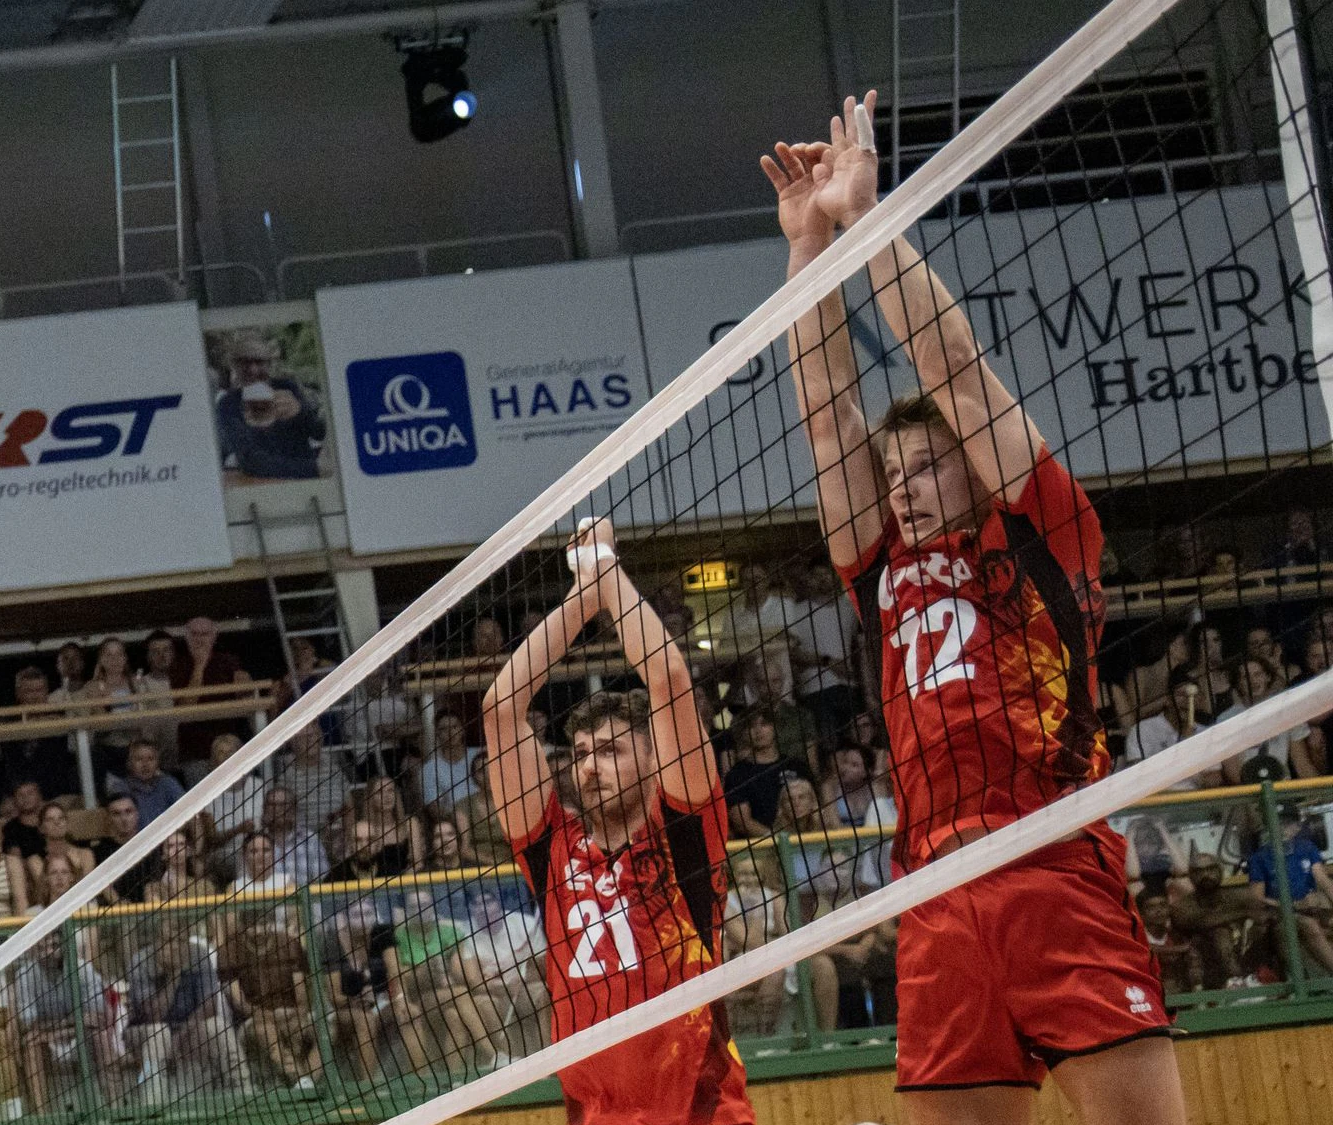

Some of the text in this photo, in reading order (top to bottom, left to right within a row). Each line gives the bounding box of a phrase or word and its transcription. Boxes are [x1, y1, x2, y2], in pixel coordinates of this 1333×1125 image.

[490, 373, 632, 420] HAAS
[1088, 343, 1320, 408] Hartbe
[363, 422, 467, 456] UNIQA
[889, 597, 977, 701] 12
[567, 895, 638, 978] 21
